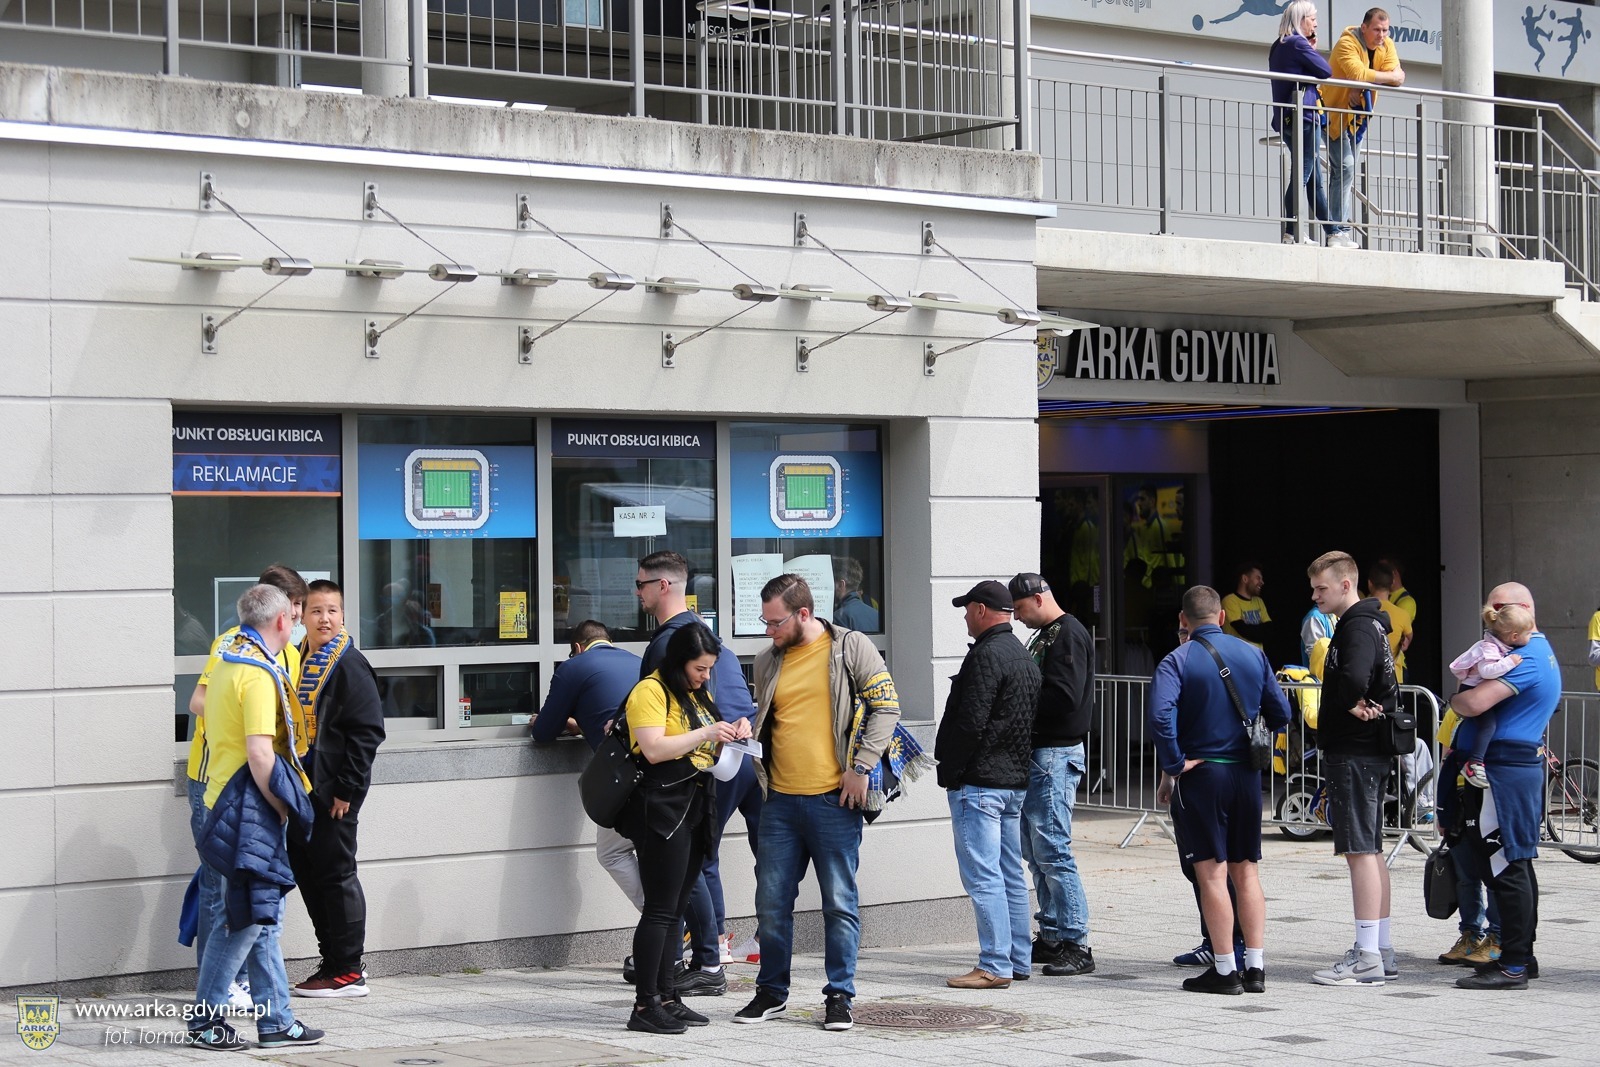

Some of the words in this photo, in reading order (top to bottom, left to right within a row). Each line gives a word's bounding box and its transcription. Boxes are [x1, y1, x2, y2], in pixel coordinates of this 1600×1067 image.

[1075, 326, 1161, 380] ARKA
[1170, 328, 1280, 384] GDYNIA
[171, 427, 214, 440] PUNKT
[217, 428, 275, 441] OBSŁUGI
[278, 429, 323, 442] KIBICA
[568, 433, 608, 446] PUNKT
[611, 434, 660, 447] OBSŁUGI
[662, 435, 700, 447] KIBICA
[192, 465, 297, 483] REKLAMACJE
[619, 512, 636, 520] KASA
[651, 511, 656, 519] 2
